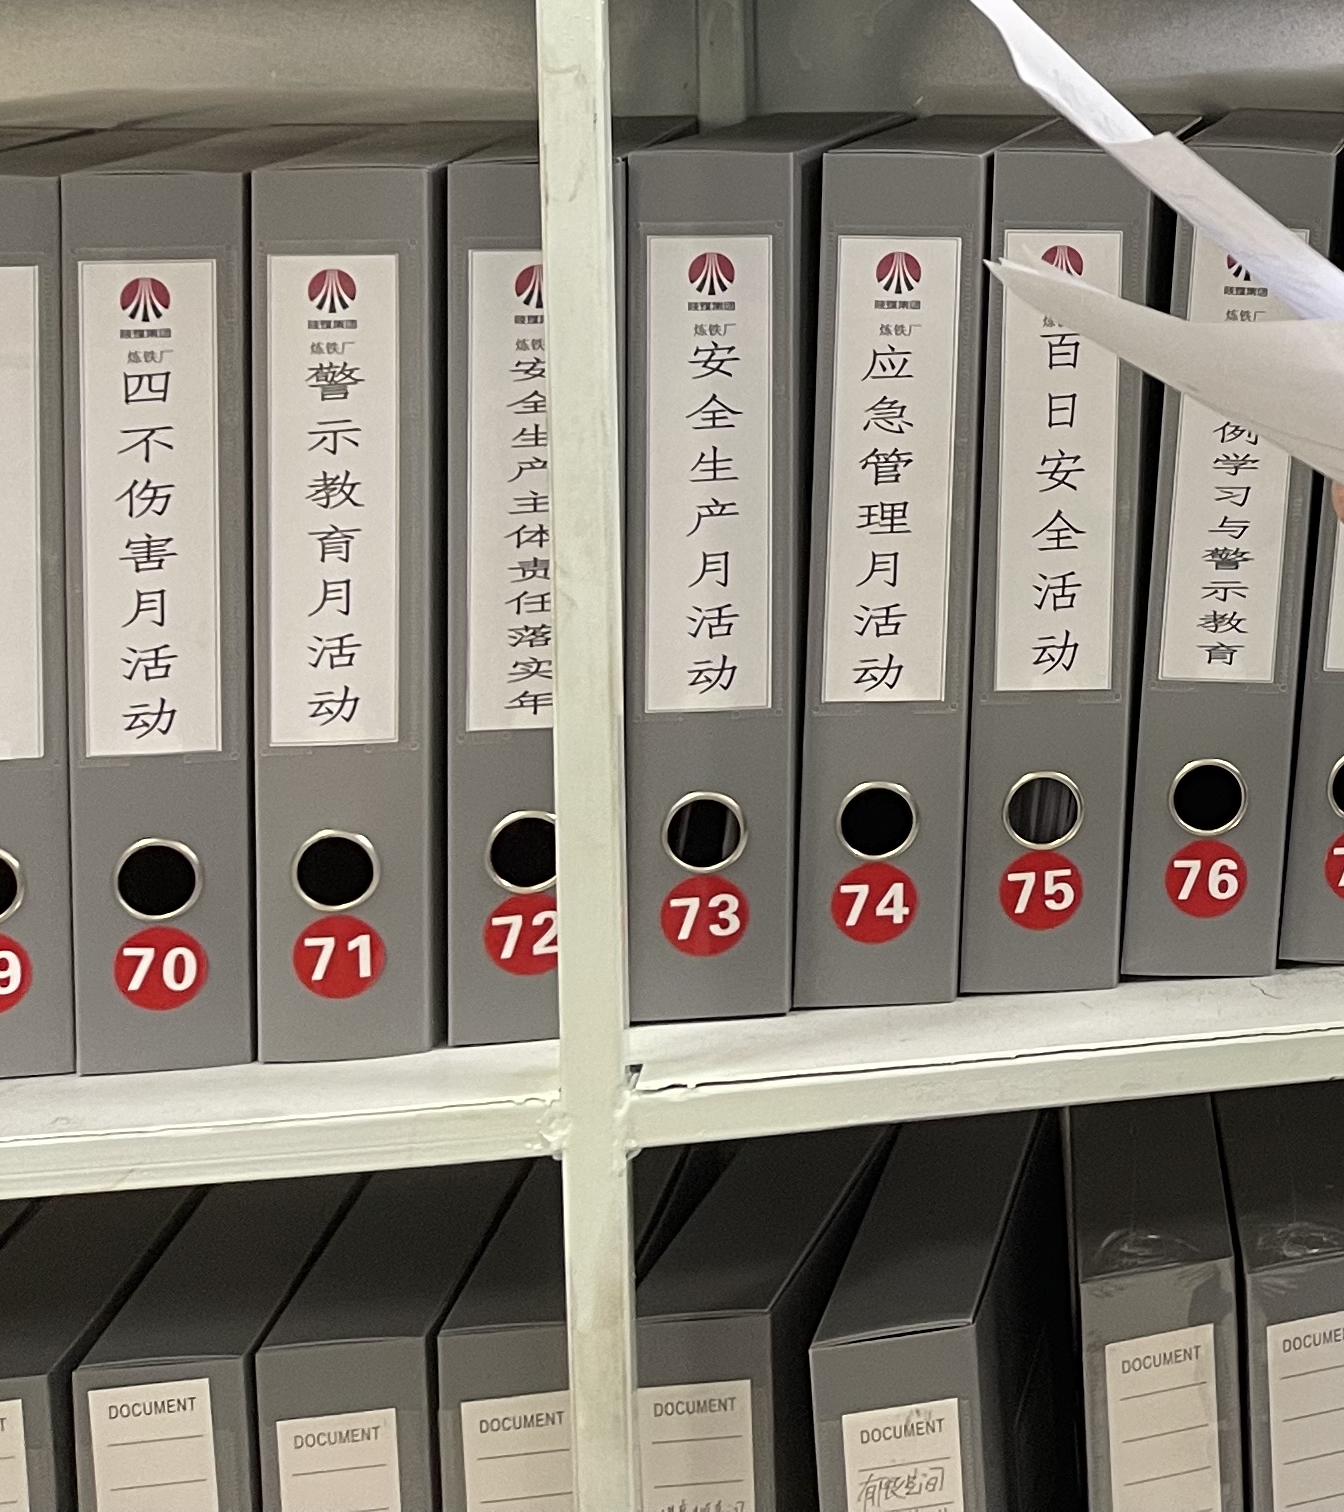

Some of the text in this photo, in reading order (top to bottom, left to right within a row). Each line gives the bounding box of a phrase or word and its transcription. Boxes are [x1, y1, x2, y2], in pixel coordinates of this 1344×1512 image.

[694, 323, 736, 336] 炼铁厂
[880, 324, 921, 336] 炼铁厂
[1224, 308, 1266, 322] 炼铁厂
[128, 350, 173, 363] 炼铁厂
[311, 342, 355, 355] 炼铁厂
[515, 338, 545, 352] 炼铁
[686, 341, 743, 694] 安全生产月活动
[853, 344, 913, 692] 应急管理月活动
[1032, 333, 1086, 674] 百日安全活动
[116, 371, 178, 739] 四不伤害月活动
[305, 362, 365, 726] 警示教育月活动
[1198, 421, 1261, 667] 例学习与警示教育
[1008, 869, 1074, 913] 75
[1174, 859, 1238, 899] 76
[670, 894, 739, 939] 73
[841, 883, 909, 925] 74
[490, 906, 559, 960] 72
[0, 950, 22, 995] 9
[123, 947, 196, 990] 70
[305, 935, 370, 980] 71
[1121, 1345, 1202, 1375] DOCUMENT
[108, 1396, 197, 1421] DOCUMENT
[478, 1411, 564, 1435] DOCUMENT
[653, 1397, 736, 1417] DOCUMENT
[293, 1425, 381, 1450] DOCUMENT
[860, 1419, 945, 1444] DOCUMENT
